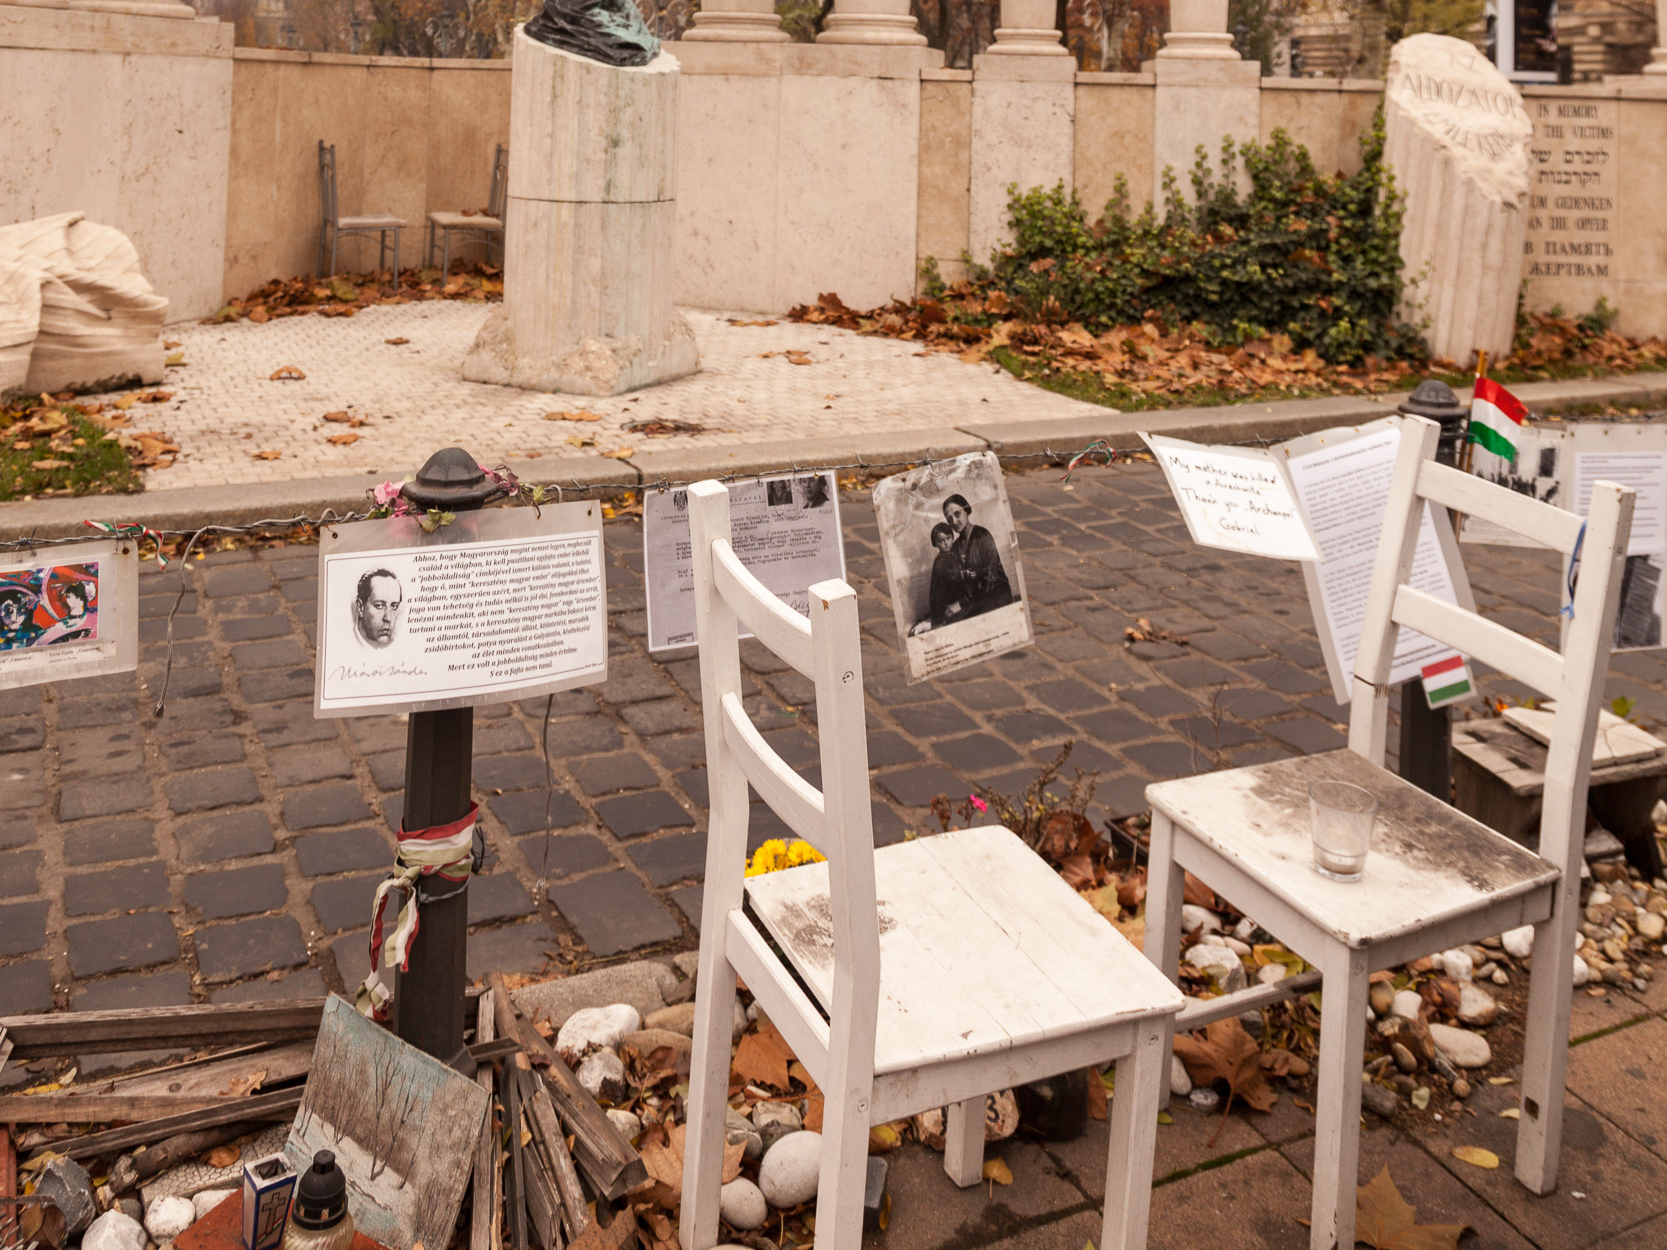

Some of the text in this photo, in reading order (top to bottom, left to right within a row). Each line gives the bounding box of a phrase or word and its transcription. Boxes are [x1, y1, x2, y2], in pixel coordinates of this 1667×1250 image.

[1537, 104, 1600, 119] IN MEMORY
[1544, 124, 1565, 139] THE
[1571, 125, 1614, 140] VICTIMS
[1529, 196, 1613, 210] UM GEDENKEN
[1528, 216, 1609, 231] AN DIE OPFER
[1545, 241, 1614, 257] ПАМЯТЬ
[1528, 261, 1609, 277] ЖЕРТВАМ
[1169, 455, 1277, 485] My mother was killed
[1180, 487, 1217, 505] Thank
[1219, 517, 1260, 535] Gabriel
[413, 554, 437, 562] Ahhoz,
[460, 548, 508, 559] Magyarország
[419, 564, 442, 572] család
[450, 561, 484, 570] világban,
[493, 558, 506, 566] kell
[476, 567, 511, 578] címkéjével
[512, 565, 530, 574] ismert
[449, 582, 466, 590] mint
[509, 575, 531, 584] magyar
[414, 594, 448, 603] világban,
[450, 589, 490, 600] egyszerűen
[492, 587, 510, 596] azért,
[409, 606, 426, 614] joga
[443, 602, 474, 610] tehetség
[485, 598, 503, 607] tudás
[408, 615, 434, 624] lenézni
[436, 612, 476, 621] mindenkit,
[409, 625, 435, 634] tartani
[444, 622, 474, 630] markát,
[487, 616, 521, 626] keresztény
[522, 614, 543, 622] magyar
[424, 643, 476, 653] zsidóbirtokot,
[478, 641, 496, 649] potya
[499, 635, 528, 646] nyaralást
[437, 632, 469, 641] államtól,
[482, 649, 494, 657] élet
[496, 647, 520, 656] minden
[497, 653, 538, 667] jobboldaliság
[539, 651, 558, 660] minden
[510, 667, 524, 676] fajta
